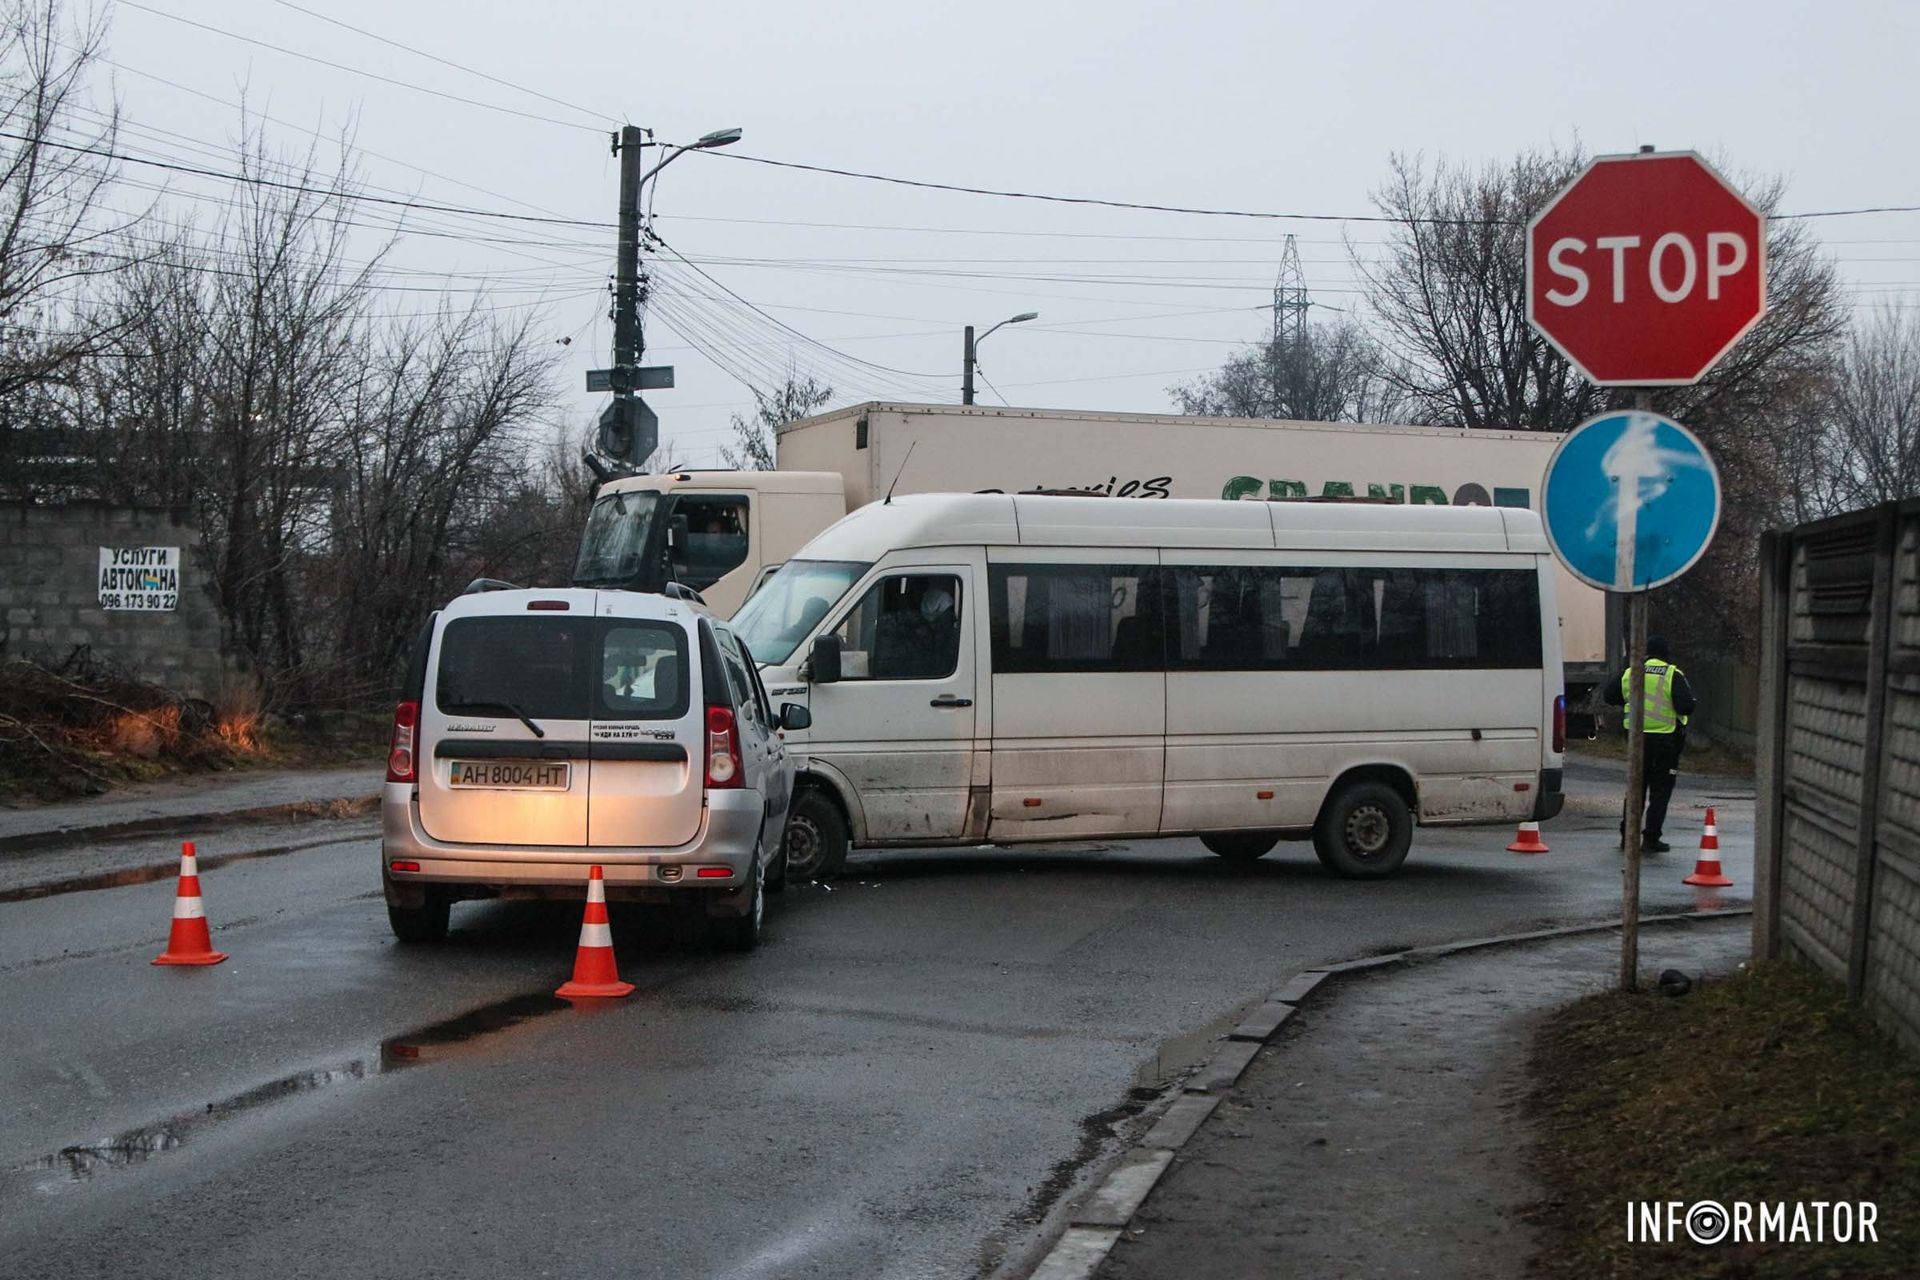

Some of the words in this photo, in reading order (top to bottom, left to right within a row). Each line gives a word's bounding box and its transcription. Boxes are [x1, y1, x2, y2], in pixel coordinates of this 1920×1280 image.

[1545, 232, 1748, 307] STOP
[112, 548, 167, 565] УСЛУГИ
[101, 594, 121, 608] 096
[125, 594, 143, 608] 173
[147, 594, 160, 608] 90
[163, 594, 176, 608] 22
[462, 766, 488, 783] AH
[491, 766, 533, 783] 8004
[537, 766, 562, 784] HT
